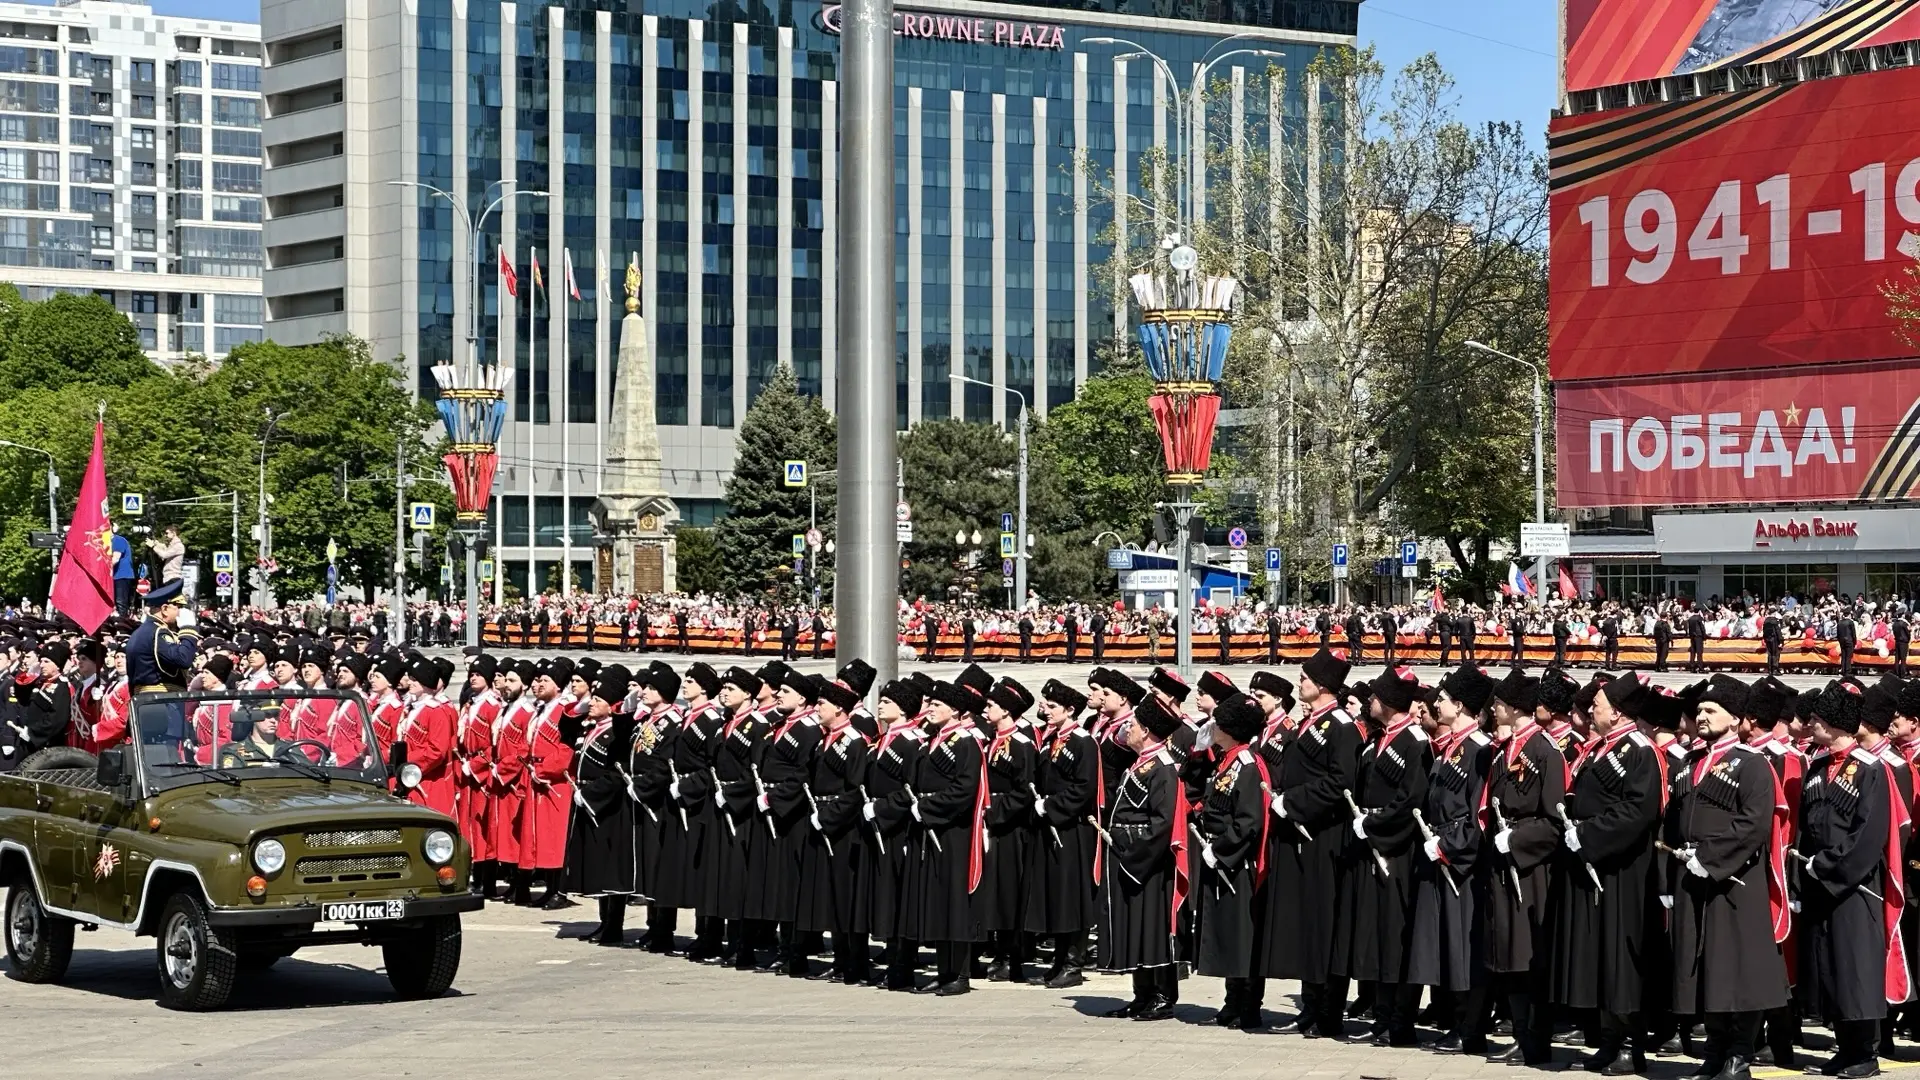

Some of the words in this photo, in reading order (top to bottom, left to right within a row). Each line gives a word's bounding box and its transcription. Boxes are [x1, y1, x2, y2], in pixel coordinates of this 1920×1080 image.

[995, 21, 1065, 48] PLAZA
[1590, 406, 1856, 479] ПОБЕДА!
[1756, 518, 1811, 543] Альфа
[1812, 517, 1859, 537] Банк
[389, 901, 403, 912] 23
